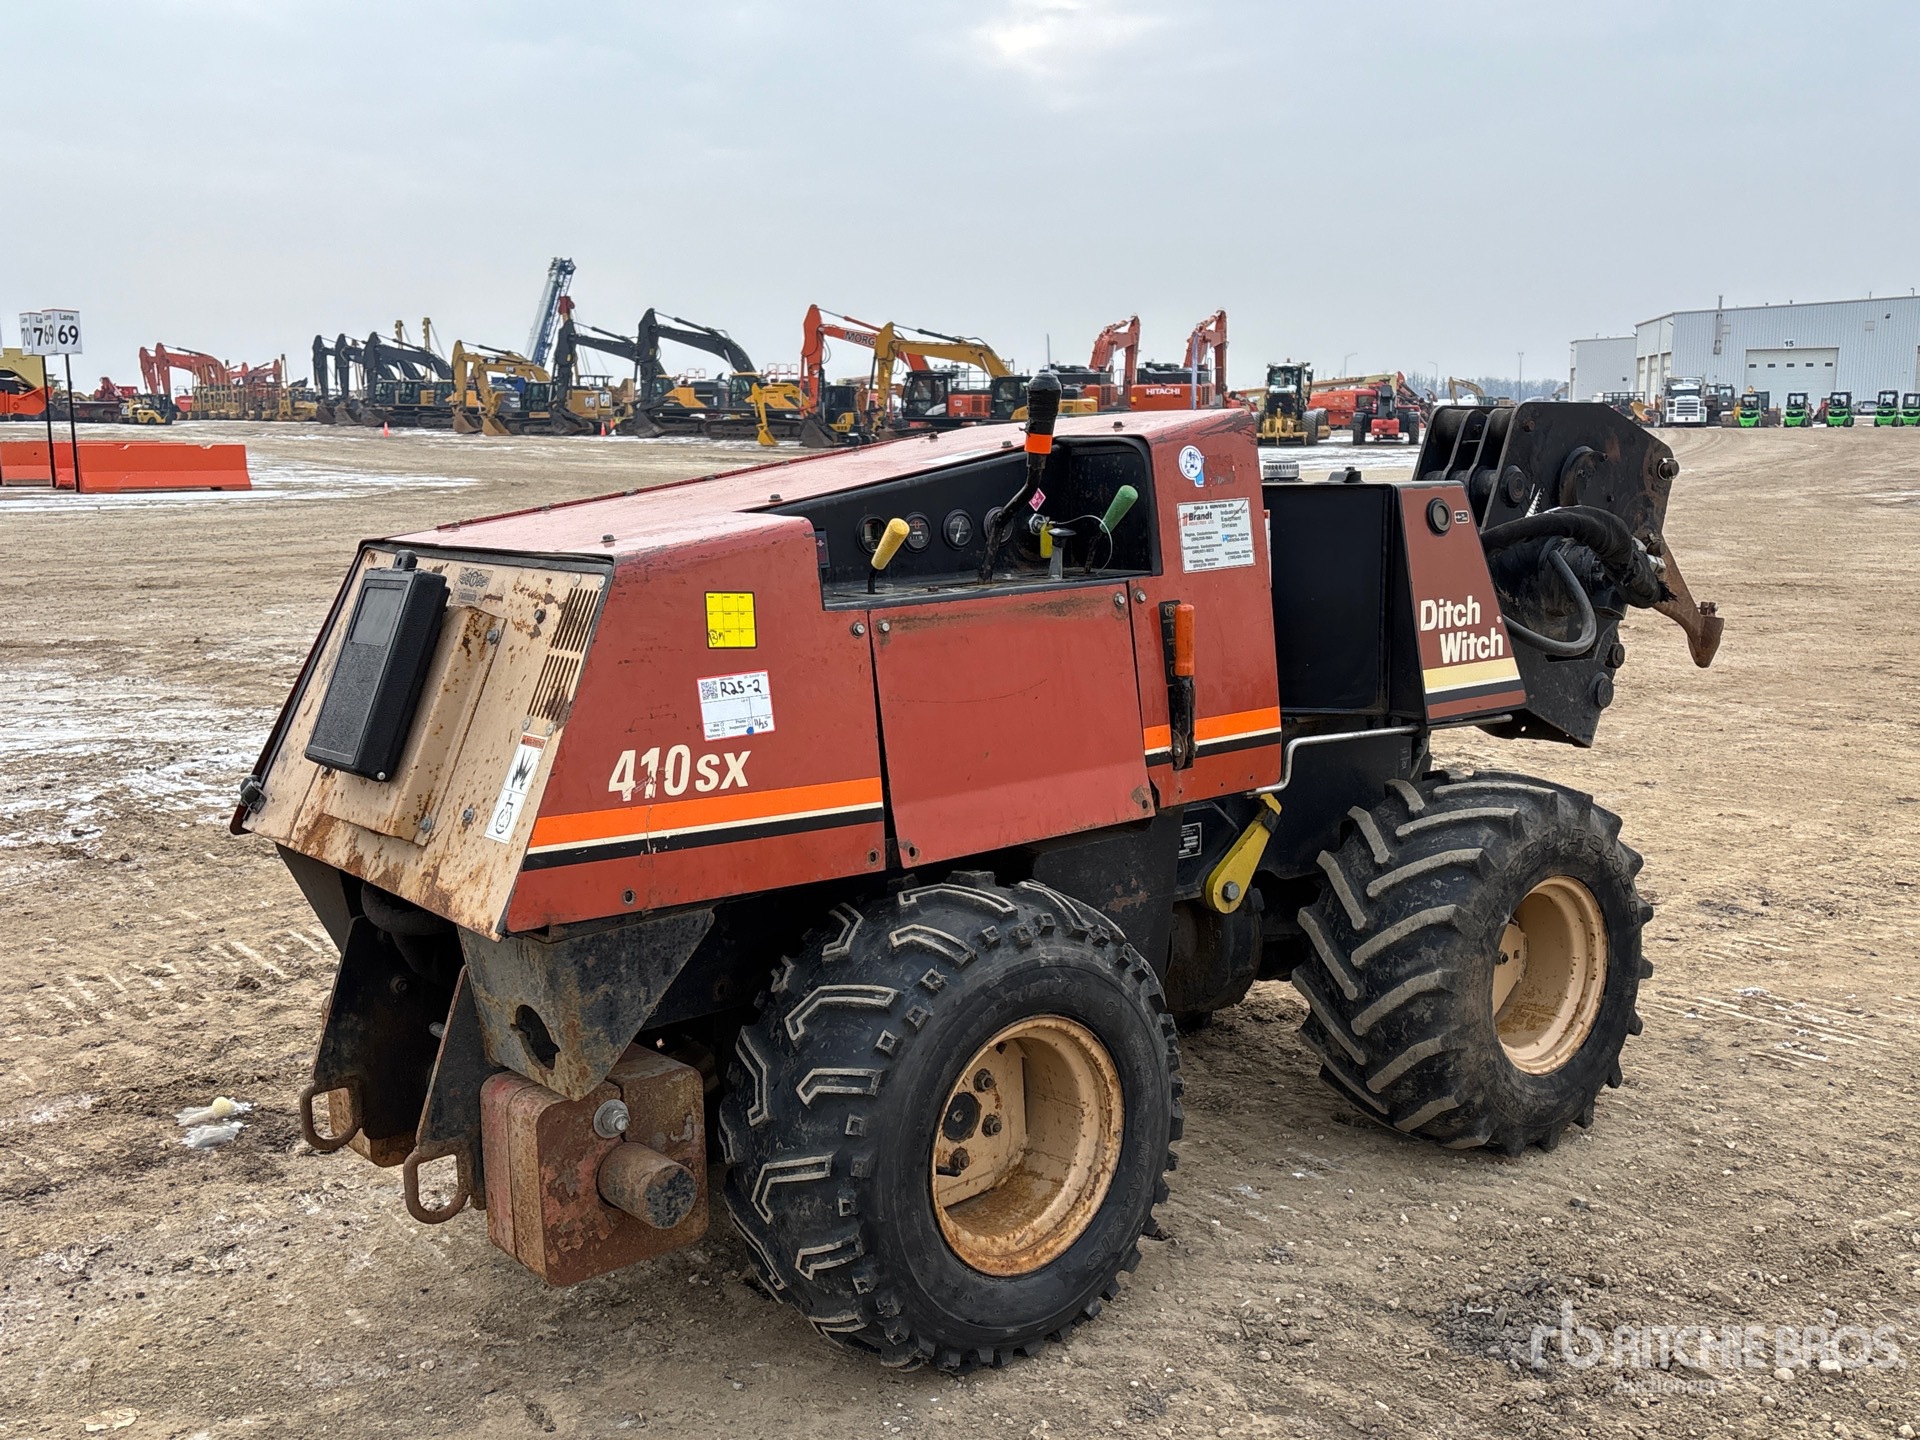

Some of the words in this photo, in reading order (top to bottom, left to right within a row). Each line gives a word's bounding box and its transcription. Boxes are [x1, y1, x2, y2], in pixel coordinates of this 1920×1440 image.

[35, 316, 43, 324] La
[59, 313, 75, 321] Lane
[21, 327, 31, 347] 70
[33, 327, 44, 346] 7
[44, 324, 54, 345] 69
[58, 324, 79, 345] 69
[846, 331, 876, 346] MORG
[1188, 511, 1213, 521] Brandt
[1420, 595, 1481, 631] Ditch
[1440, 627, 1504, 664] Witch
[720, 679, 762, 697] R25-2
[1572, 828, 1639, 926] POWER
[1086, 1141, 1153, 1271] MAXXIS
